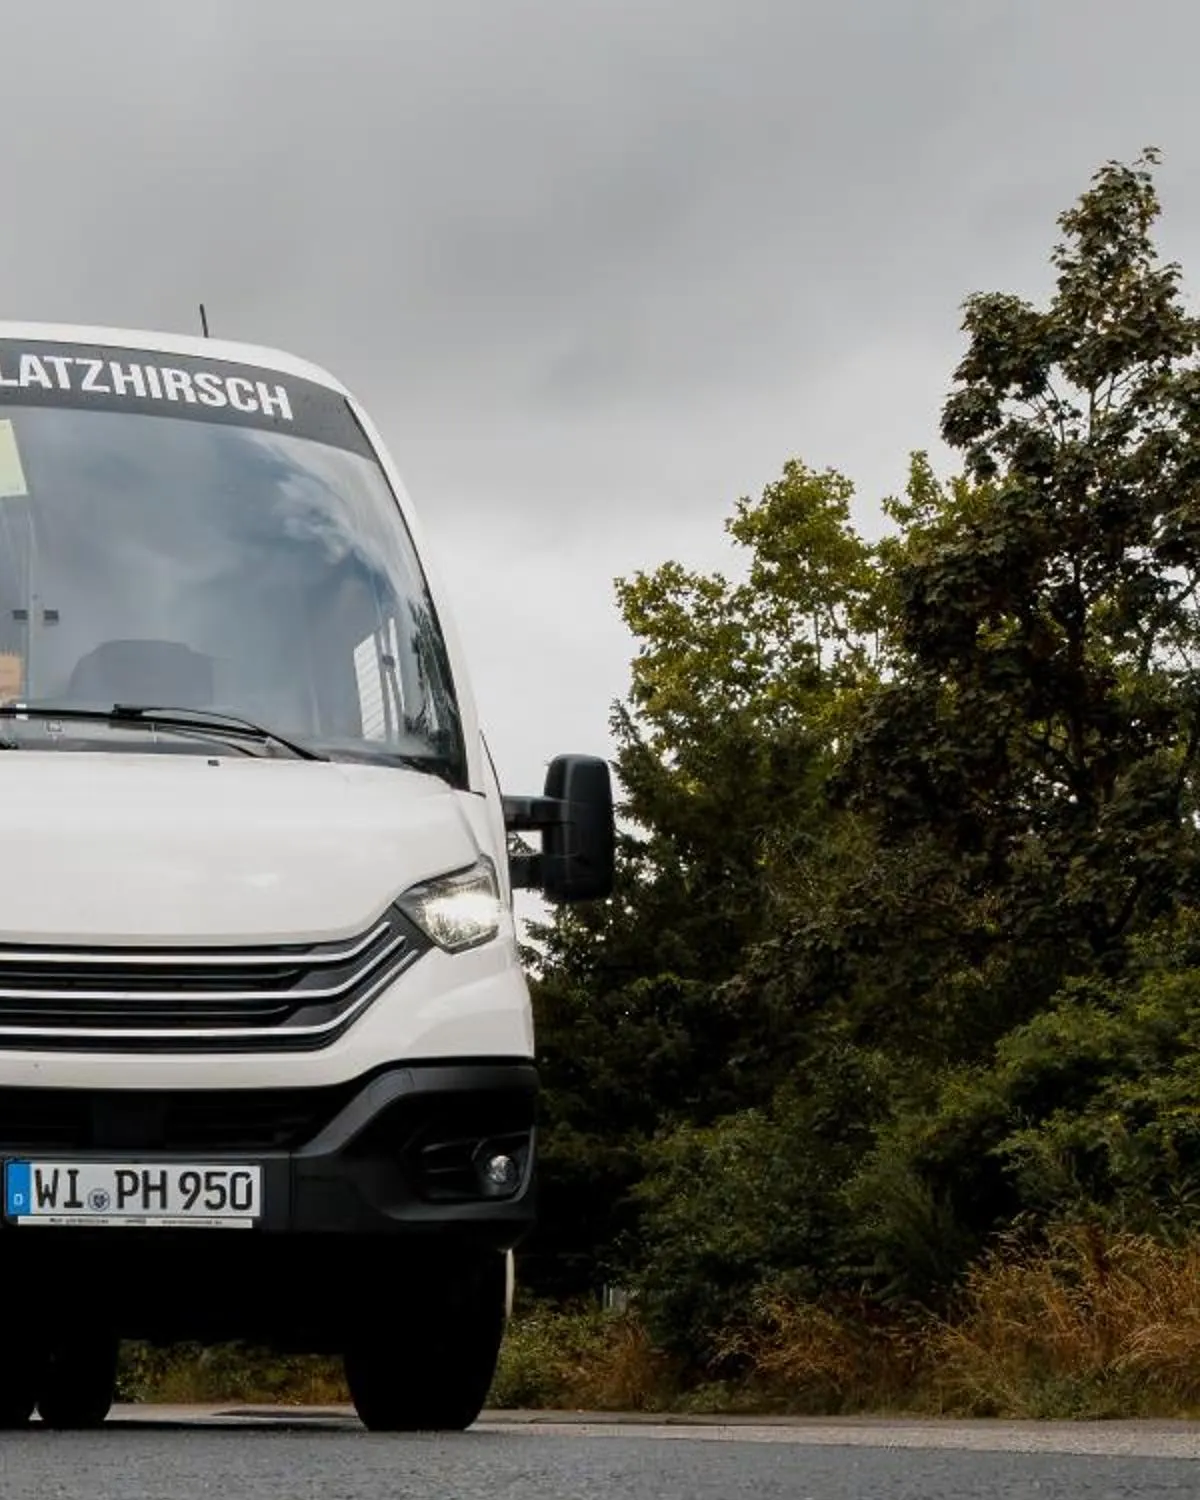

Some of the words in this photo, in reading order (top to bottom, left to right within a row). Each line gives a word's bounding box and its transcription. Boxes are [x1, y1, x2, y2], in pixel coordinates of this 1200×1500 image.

[13, 1193, 24, 1206] D
[34, 1168, 84, 1209] WI
[114, 1169, 169, 1210] PH
[178, 1171, 253, 1211] 950
